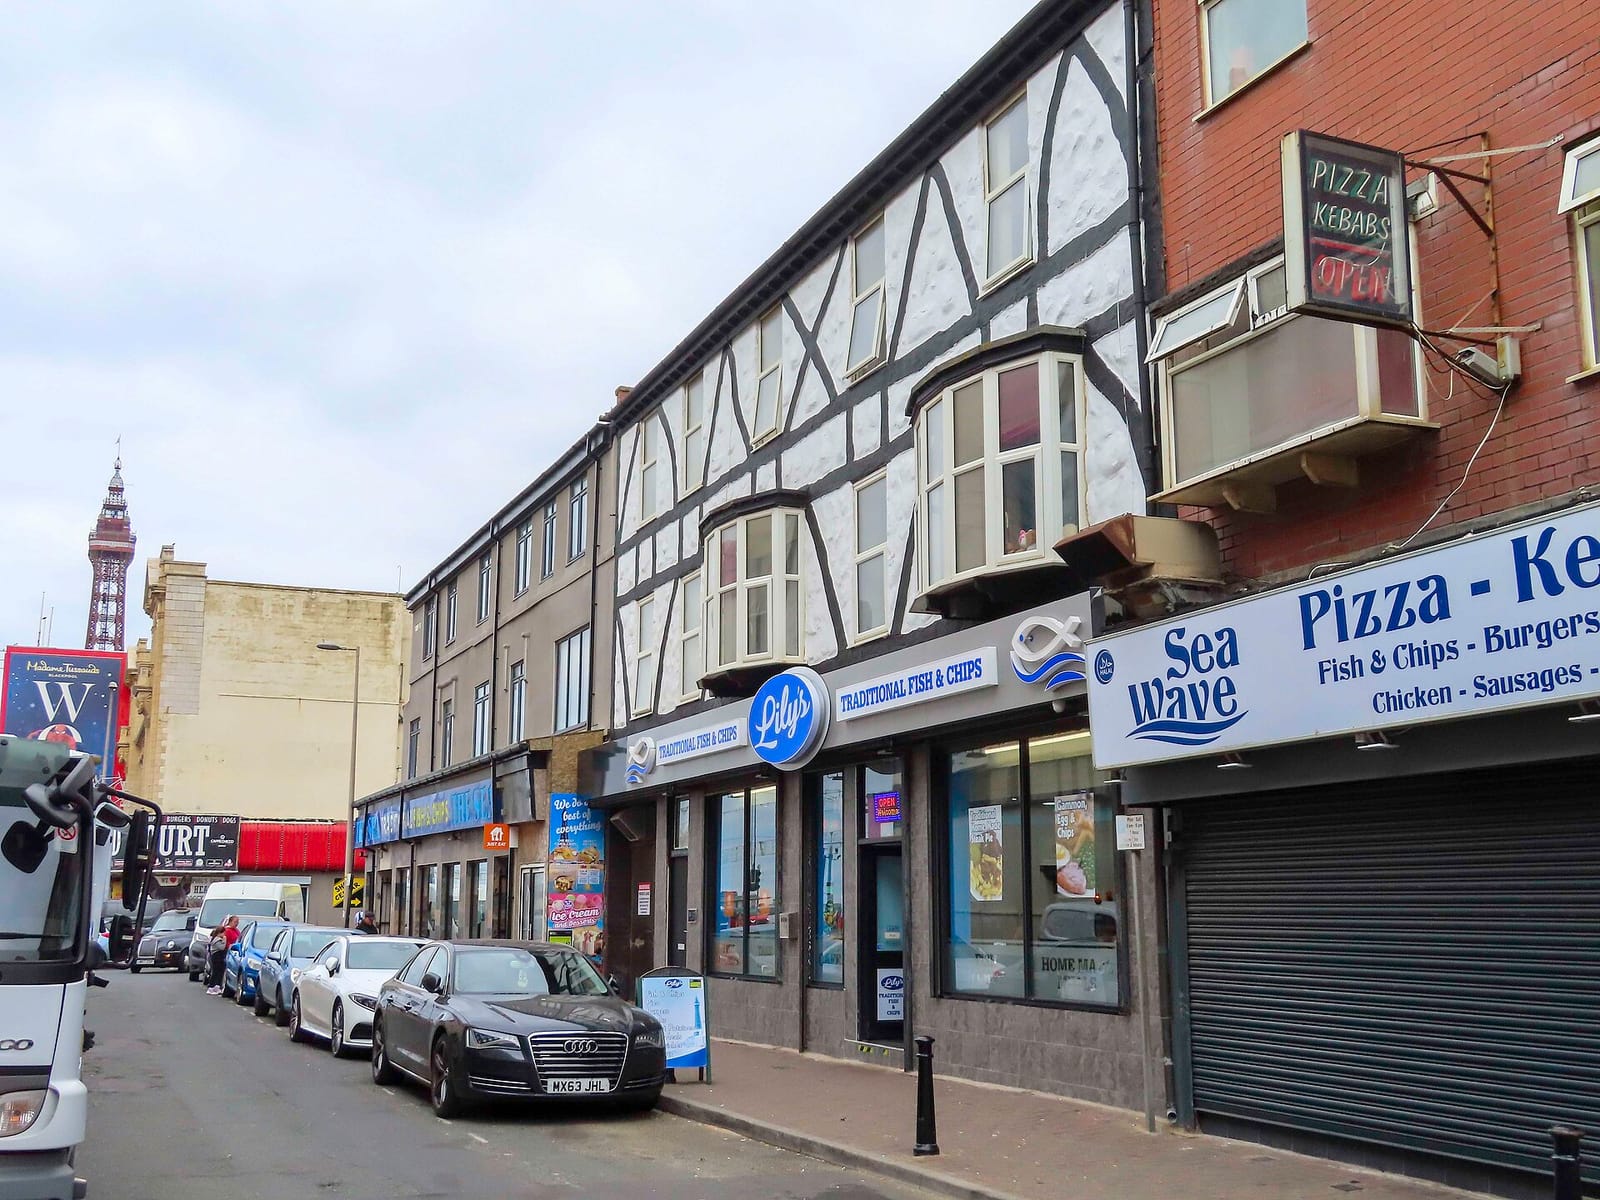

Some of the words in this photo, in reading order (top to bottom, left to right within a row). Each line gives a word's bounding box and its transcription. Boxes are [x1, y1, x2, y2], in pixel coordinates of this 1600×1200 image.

[1312, 160, 1390, 206] PIZZA
[1313, 201, 1391, 240] KEBABS
[1312, 254, 1393, 304] OPEN
[1298, 574, 1452, 651] Pizza
[1165, 627, 1240, 681] Sea
[1318, 653, 1364, 684] Fish
[1370, 649, 1387, 674] &
[1393, 639, 1460, 670] Chips
[1483, 610, 1600, 654] Burgers
[27, 660, 65, 673] Madame
[63, 662, 100, 674] Tussauds
[841, 679, 906, 713] TRADITIONAL
[908, 671, 934, 695] FISH
[936, 668, 944, 688] &
[946, 657, 982, 685] CHIPS
[1372, 686, 1452, 714] Chicken
[1473, 663, 1583, 698] Sausages
[755, 684, 811, 749] Lily's
[659, 736, 697, 759] TRADITIONAL
[696, 732, 711, 750] FISH
[712, 731, 717, 747] &
[718, 725, 738, 745] CHIPS
[553, 799, 571, 810] We
[563, 810, 581, 821] best
[582, 808, 591, 821] of
[879, 797, 896, 808] OPEN
[555, 820, 602, 835] everything
[1056, 826, 1075, 840] Chips
[551, 911, 568, 922] Ice
[568, 908, 600, 920] Cream
[1041, 956, 1075, 971] HOME
[553, 1080, 582, 1092] MX63
[585, 1080, 605, 1092] JHL
